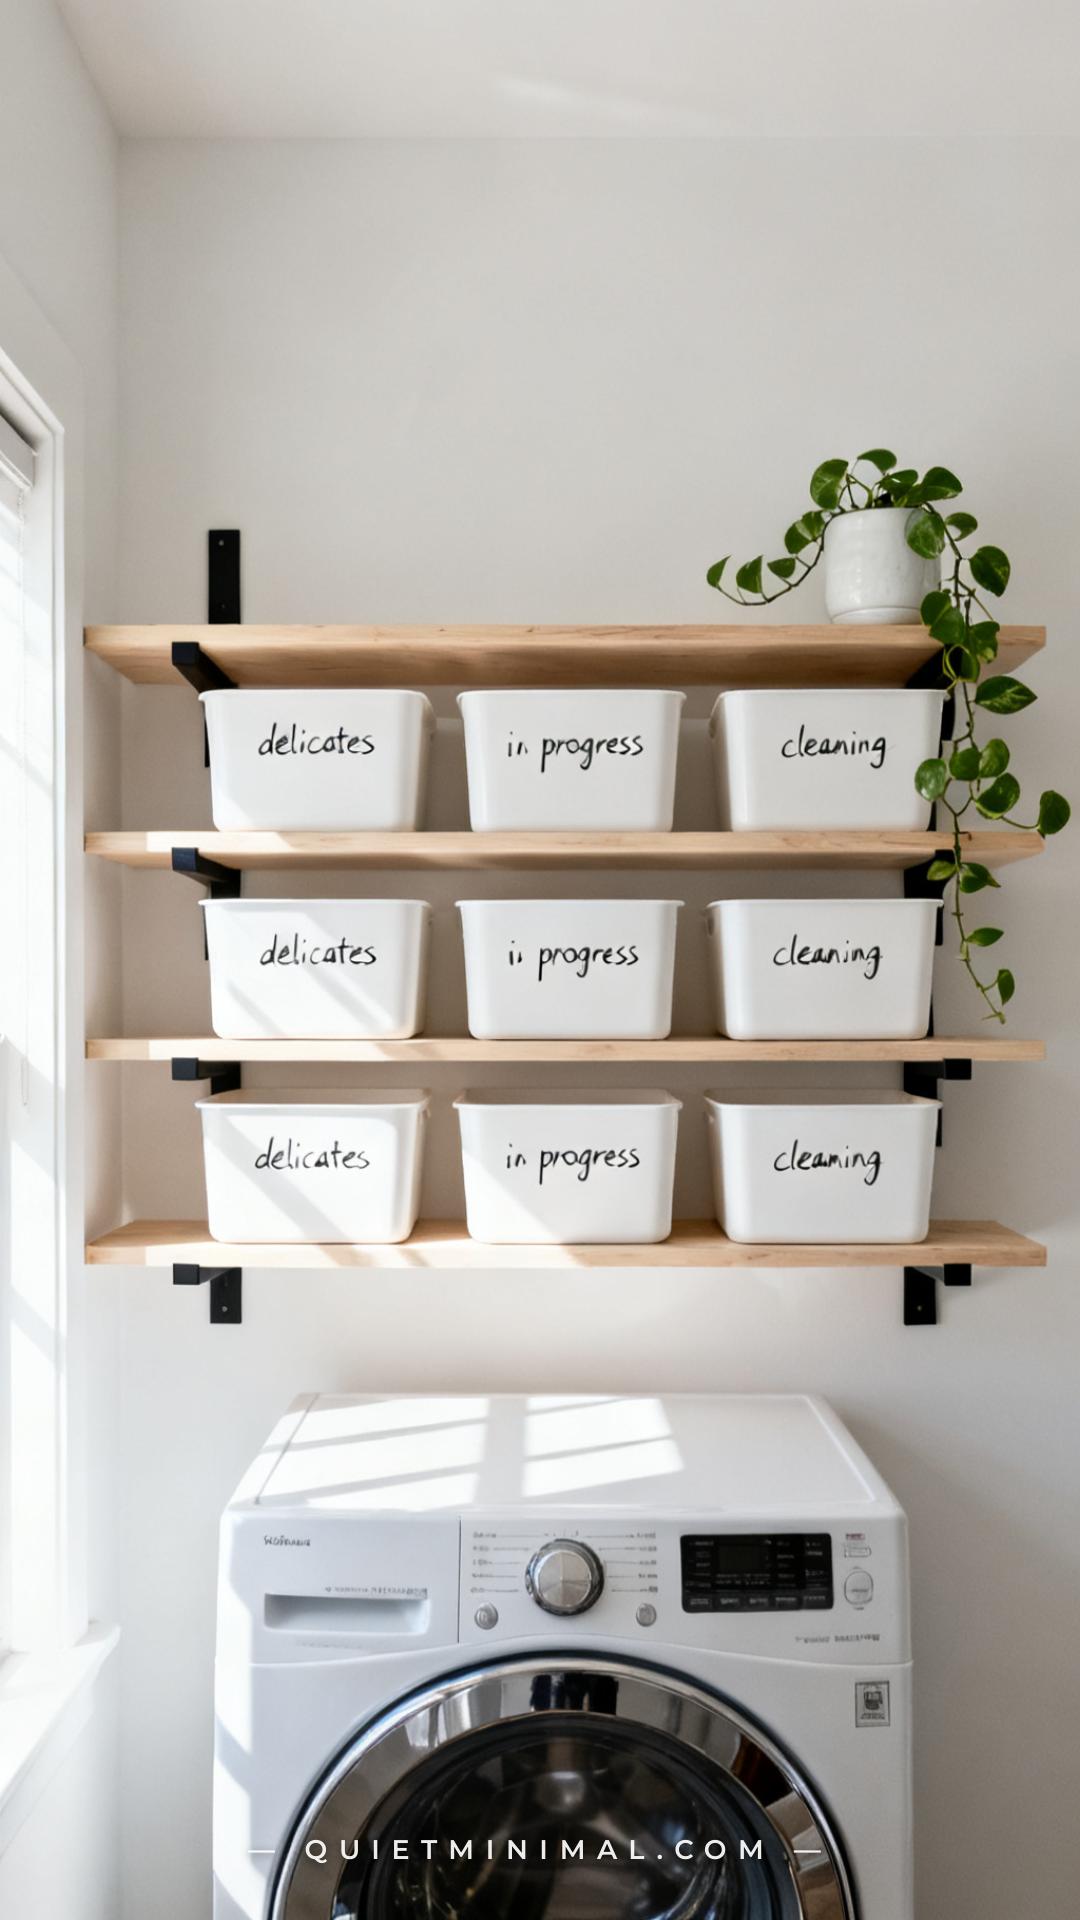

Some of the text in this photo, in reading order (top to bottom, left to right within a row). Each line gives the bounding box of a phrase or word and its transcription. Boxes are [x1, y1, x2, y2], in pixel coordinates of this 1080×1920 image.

[258, 721, 376, 757] delicates
[507, 730, 644, 774] in progress
[780, 723, 887, 770] cleaning
[259, 932, 378, 967] delicates
[538, 944, 640, 982] progress
[772, 933, 883, 981] cleaning
[254, 1136, 371, 1171] delicates
[505, 1142, 641, 1186] in progress
